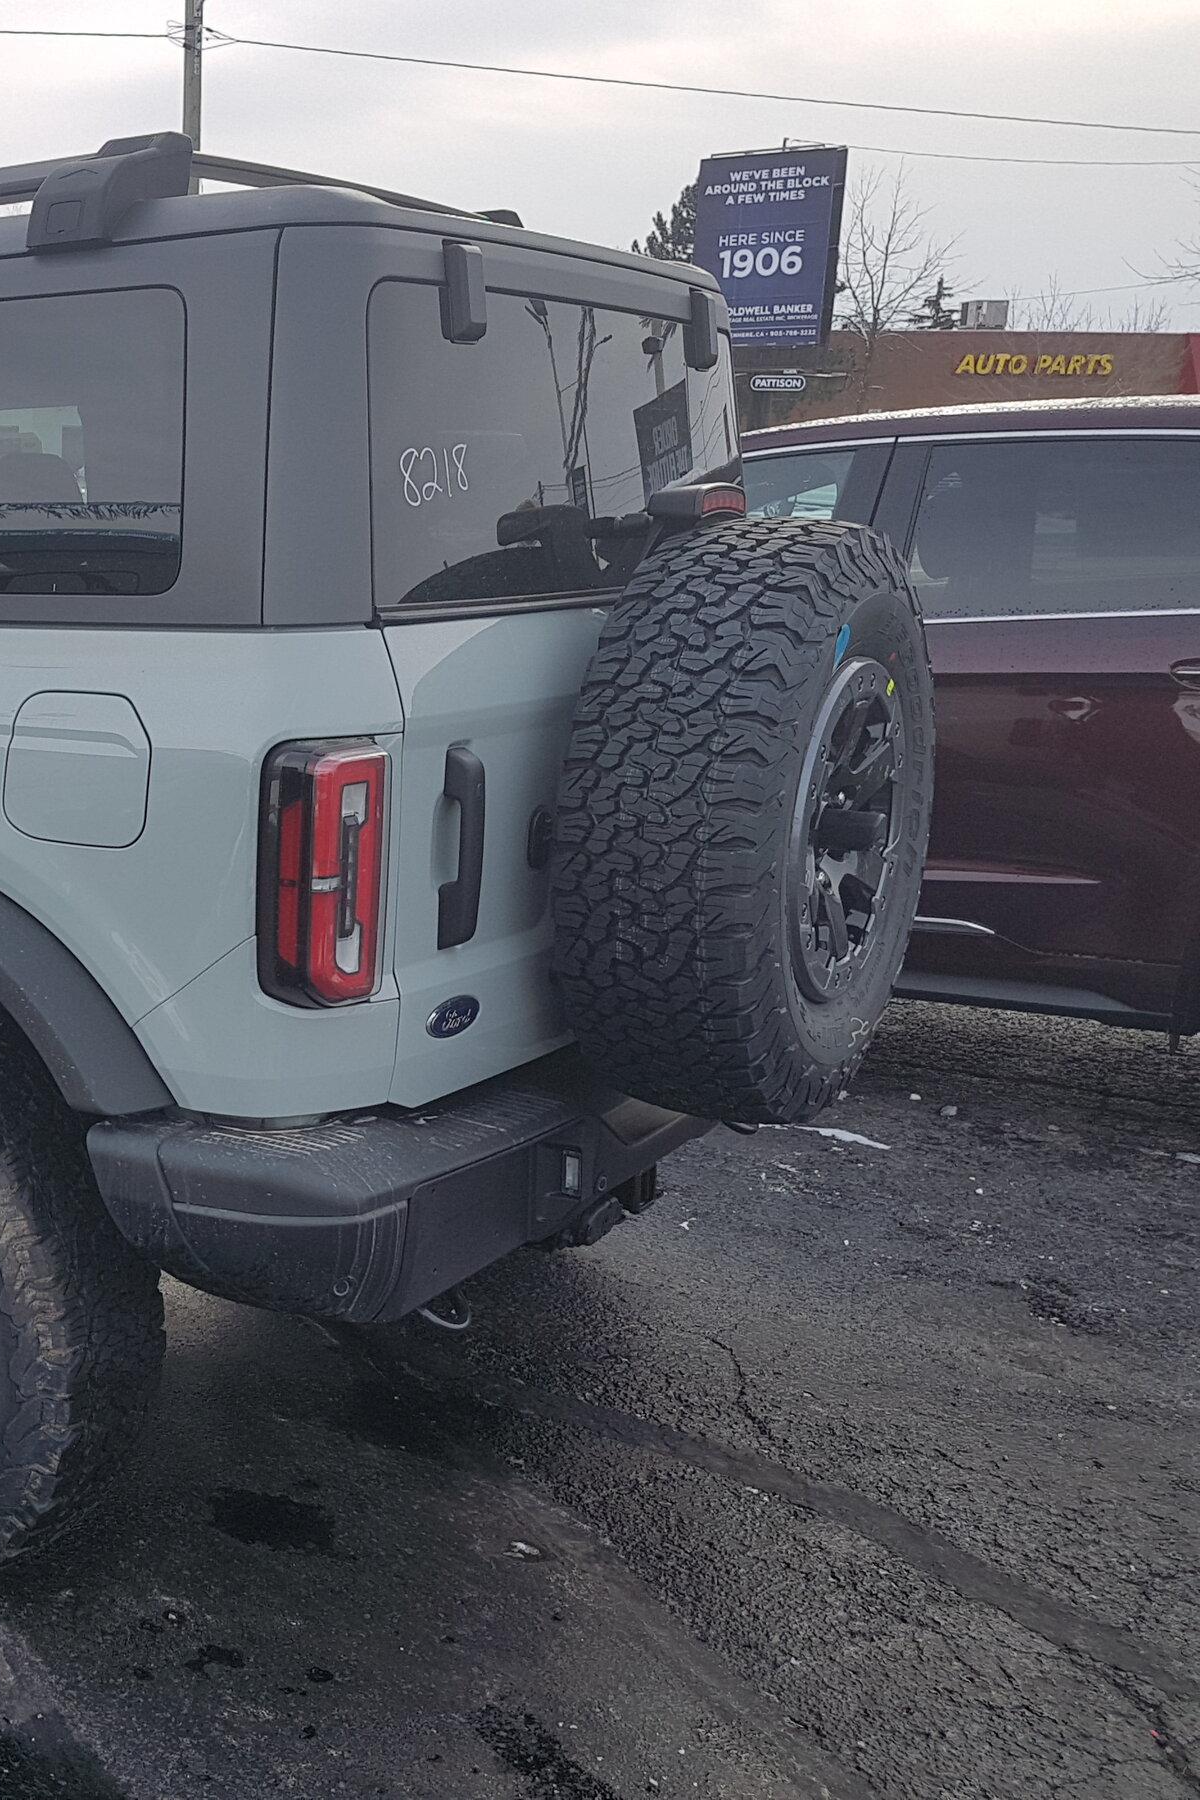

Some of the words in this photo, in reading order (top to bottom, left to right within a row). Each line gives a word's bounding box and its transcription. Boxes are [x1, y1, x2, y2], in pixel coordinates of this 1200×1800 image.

[730, 169, 770, 182] WE'VE
[772, 166, 805, 179] BEEN
[705, 182, 757, 196] AROUND
[760, 180, 784, 191] THE
[787, 176, 829, 189] BLOCK
[725, 195, 735, 206] A
[738, 192, 765, 204] FEW
[768, 189, 805, 202] TIMES
[719, 233, 758, 247] HERE
[761, 229, 805, 244] SINCE
[719, 245, 803, 279] 1906
[727, 306, 770, 317] OLDWELL
[773, 303, 813, 314] BANKER
[955, 353, 1029, 375] AUTO
[1034, 353, 1115, 376] PARTS
[754, 378, 802, 388] PATTISON
[399, 443, 469, 506] 8218
